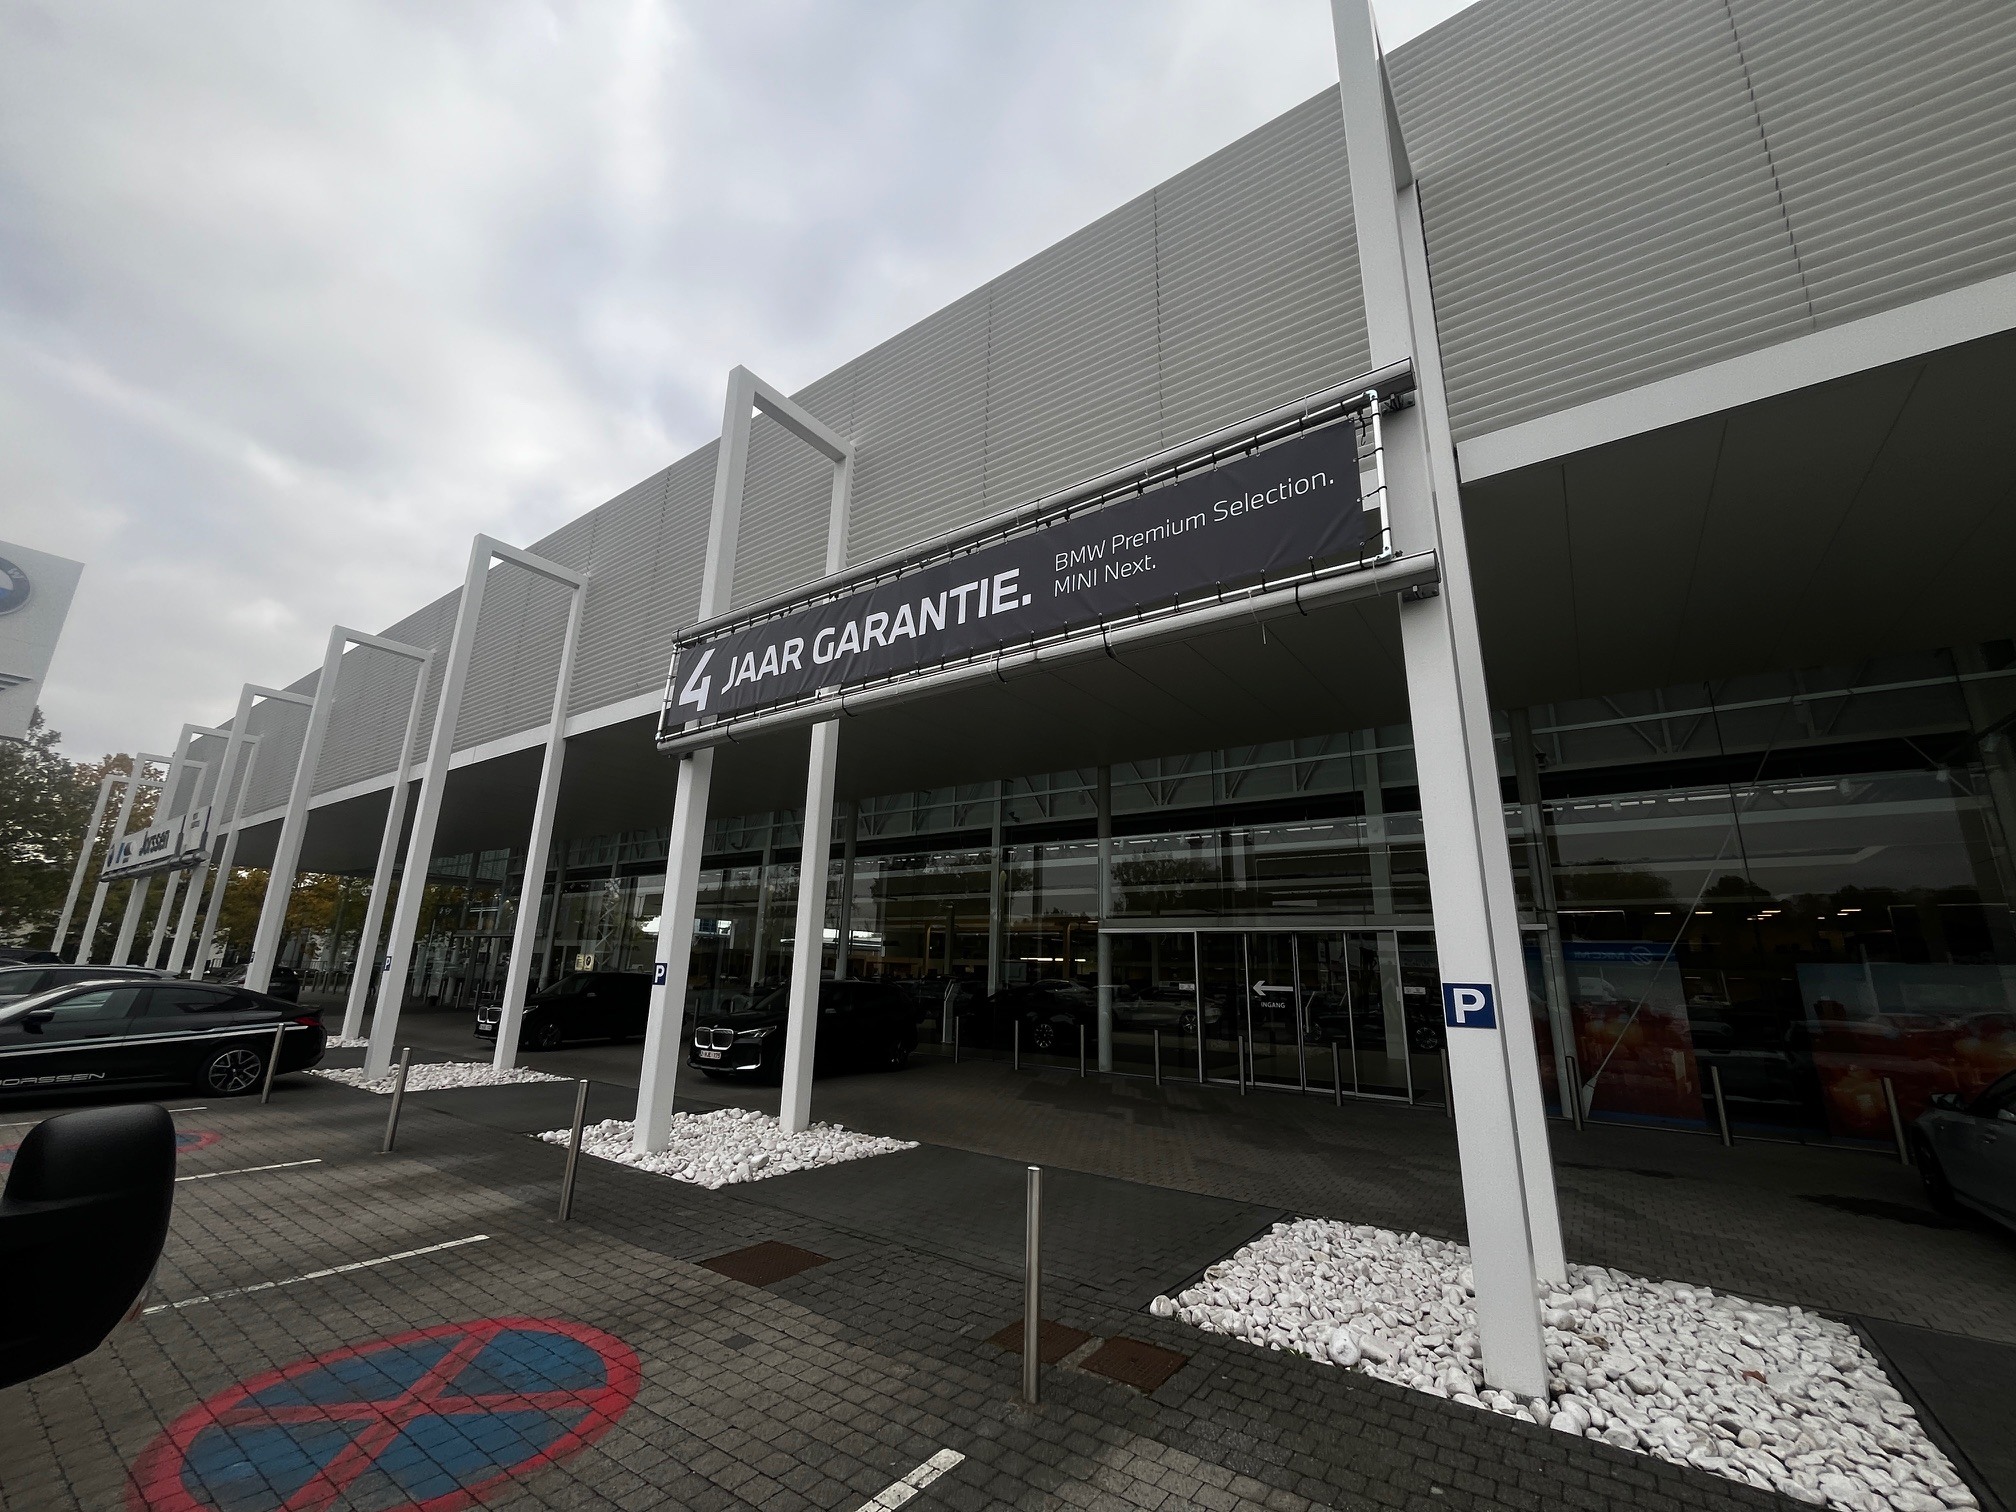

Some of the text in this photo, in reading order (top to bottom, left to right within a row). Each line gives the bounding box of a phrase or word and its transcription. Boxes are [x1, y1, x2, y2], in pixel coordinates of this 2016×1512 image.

[1055, 471, 1334, 572] BMW Premium Selection.
[1053, 554, 1156, 597] MINI Next.
[678, 568, 1032, 711] 4 JAAR GARANTIE.
[654, 964, 665, 983] P
[1260, 1001, 1286, 1009] INGANG
[1453, 988, 1485, 1023] P
[0, 1072, 106, 1087] ORSSEN
